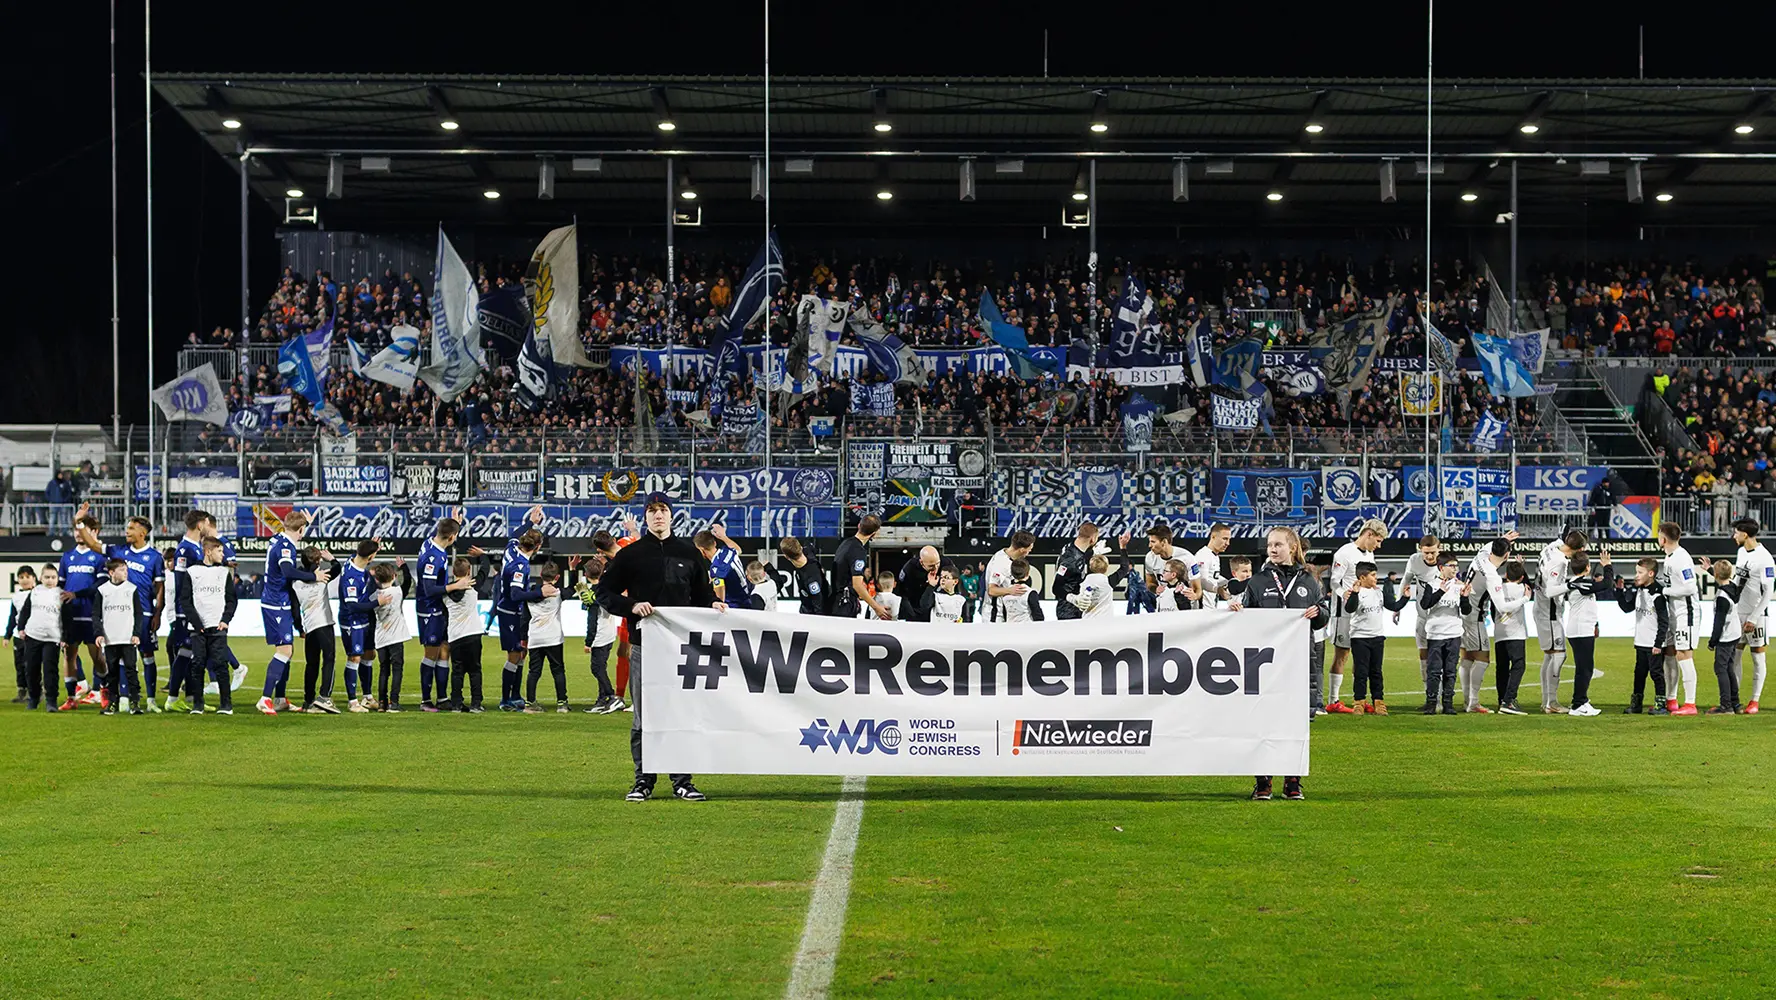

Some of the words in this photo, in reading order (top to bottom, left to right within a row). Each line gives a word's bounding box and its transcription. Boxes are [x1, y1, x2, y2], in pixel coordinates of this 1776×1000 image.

[1213, 395, 1261, 408] ULTRAS
[890, 445, 930, 454] FREIHEIT
[892, 455, 914, 465] ALEX
[917, 455, 937, 464] UND
[323, 467, 360, 479] BADEN
[1534, 469, 1587, 488] KSC
[325, 480, 388, 493] KOLLEKTIV
[644, 473, 684, 499] 02
[299, 541, 328, 551] EIMAT.
[1600, 542, 1641, 552] UNSERE
[104, 602, 132, 613] energis
[677, 629, 1275, 697] #WeRemember
[909, 719, 955, 729] WORLD
[909, 733, 957, 743] JEWISH
[909, 745, 981, 756] CONGRESS
